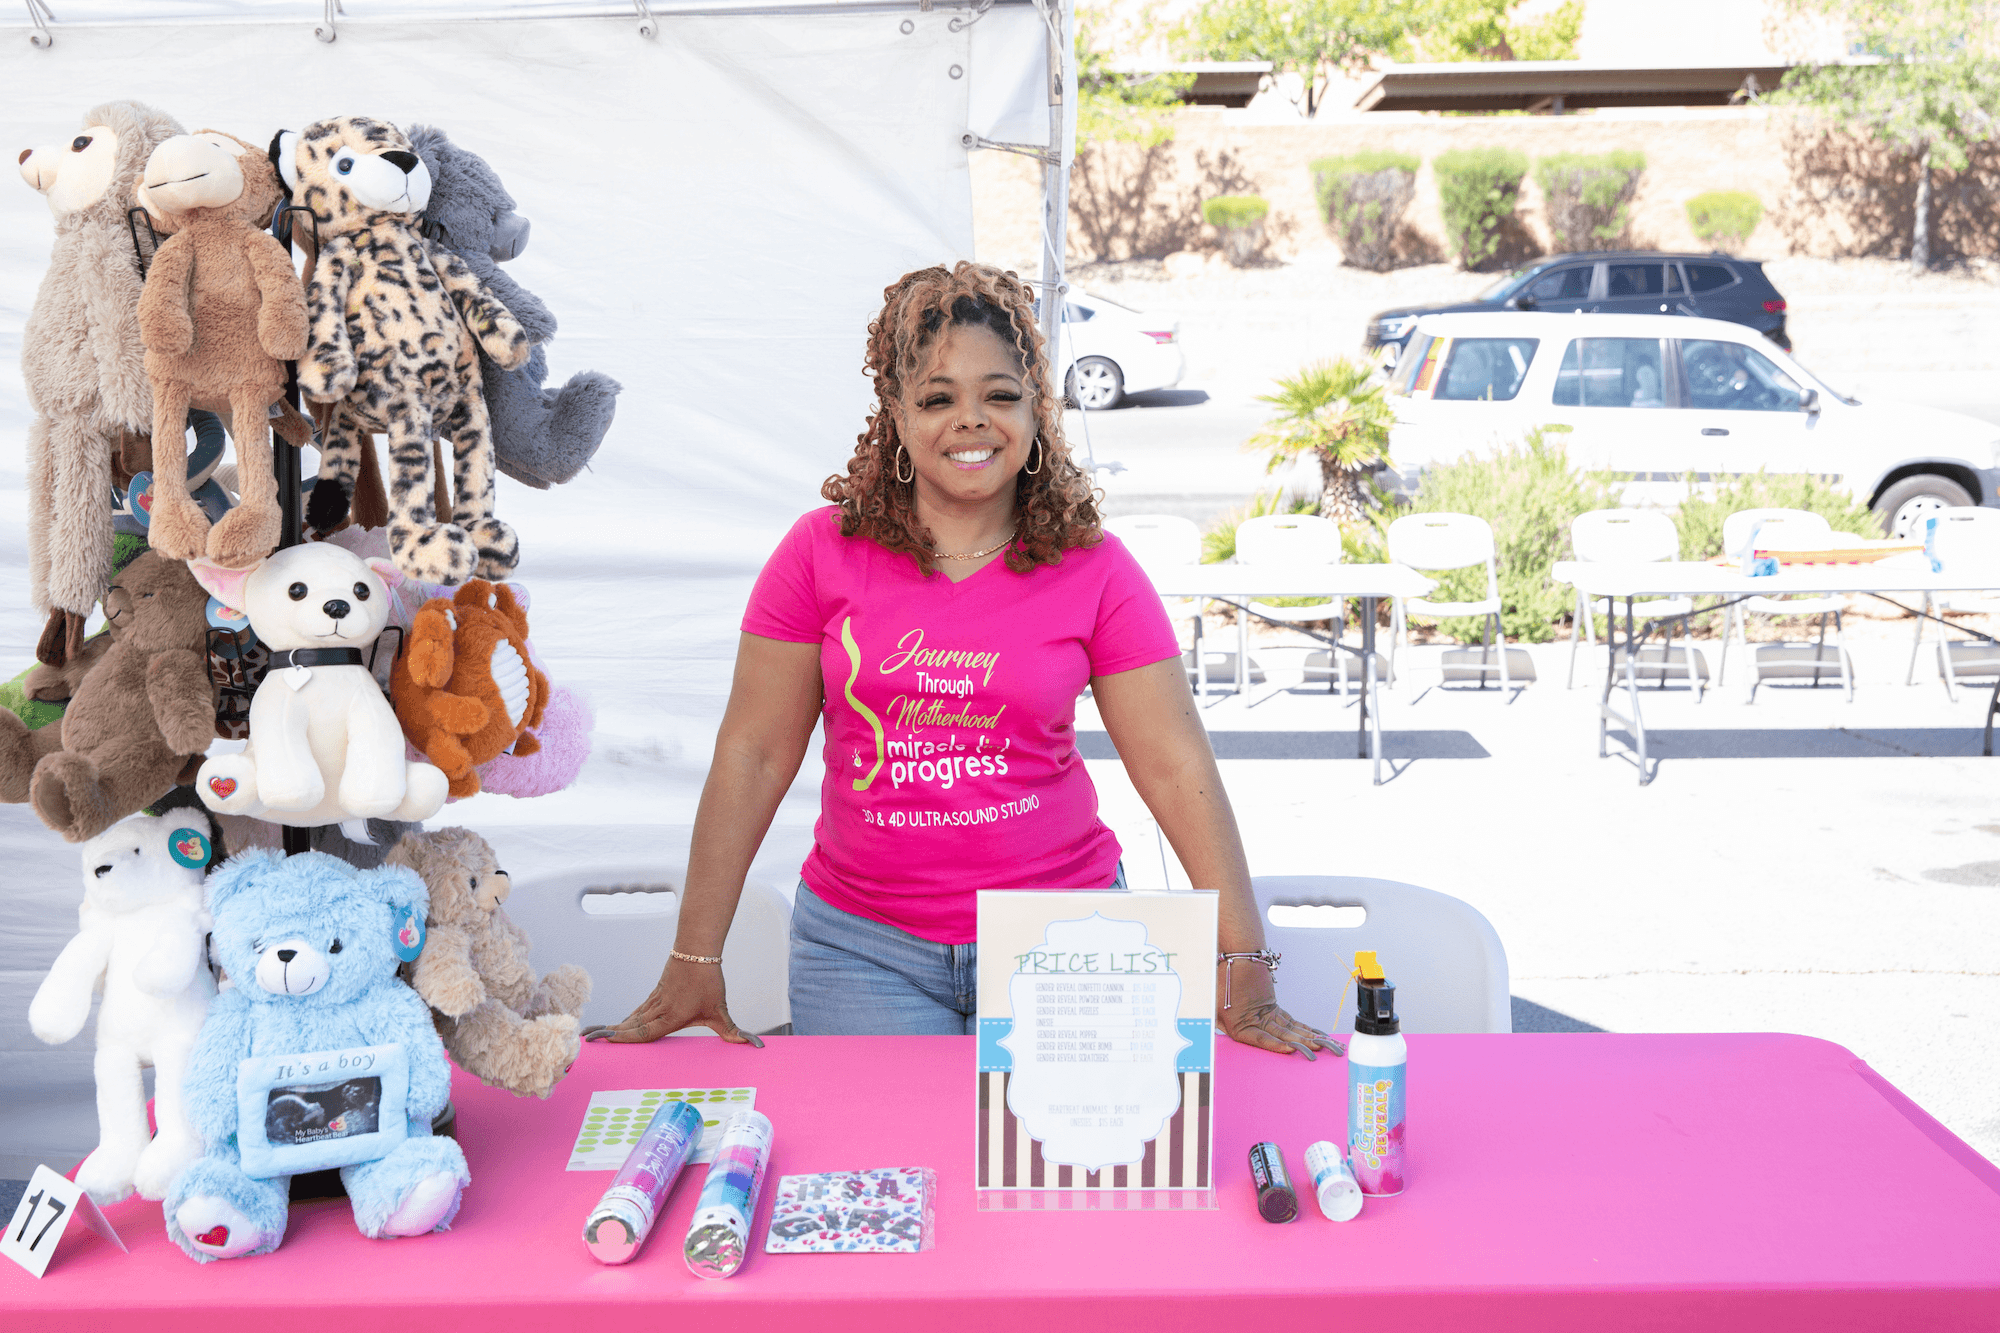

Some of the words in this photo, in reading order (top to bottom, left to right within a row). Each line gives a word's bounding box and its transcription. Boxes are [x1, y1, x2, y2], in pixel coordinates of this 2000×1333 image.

[880, 628, 1000, 687] Journey
[916, 672, 974, 698] Through
[886, 694, 1006, 733] Motherhood
[891, 754, 1008, 789] progress
[862, 808, 874, 824] 3D
[877, 811, 885, 826] &
[889, 811, 905, 827] 4D
[909, 806, 998, 827] ULTRASOUND
[1001, 794, 1039, 819] STUDIO
[1014, 951, 1099, 974] PRICE
[1111, 951, 1178, 974] LIST
[1036, 983, 1055, 992] GENDER
[1057, 983, 1076, 992] REVEAL
[1078, 983, 1101, 992] CONFETTI
[1103, 983, 1124, 992] CANNON
[1036, 1006, 1055, 1015] GENDER
[1057, 1006, 1077, 1015] REVEAL
[1079, 1006, 1099, 1015] PUZZLES
[1037, 995, 1055, 1004] GENDER
[1057, 995, 1077, 1004] REVEAL
[1079, 995, 1100, 1004] POWDER
[1101, 995, 1122, 1004] CANNON
[1037, 1030, 1056, 1039] GENDER
[1058, 1030, 1077, 1039] REVEAL
[1080, 1030, 1097, 1039] POPPER
[1037, 1042, 1056, 1050] GENDER
[1057, 1042, 1077, 1050] REVEAL
[1079, 1042, 1096, 1050] SMOKE
[1098, 1042, 1112, 1050] BOMB
[275, 1062, 311, 1080] It's
[319, 1061, 330, 1071] a
[339, 1053, 375, 1070] boy
[1036, 1054, 1055, 1062] GENDER
[1057, 1054, 1077, 1062] REVEAL
[1079, 1054, 1109, 1062] SCRATCHERS
[1048, 1104, 1080, 1114] HEARTBEAT
[1082, 1104, 1107, 1114] ANIMALS
[1355, 1085, 1374, 1152] GENDER
[295, 1129, 306, 1138] My
[307, 1127, 328, 1137] Baby's
[1376, 1092, 1388, 1155] REVEAL
[295, 1132, 333, 1143] Heartbeat
[874, 1178, 899, 1200] A
[16, 1189, 67, 1252] 17
[771, 1208, 920, 1241] GIRL
